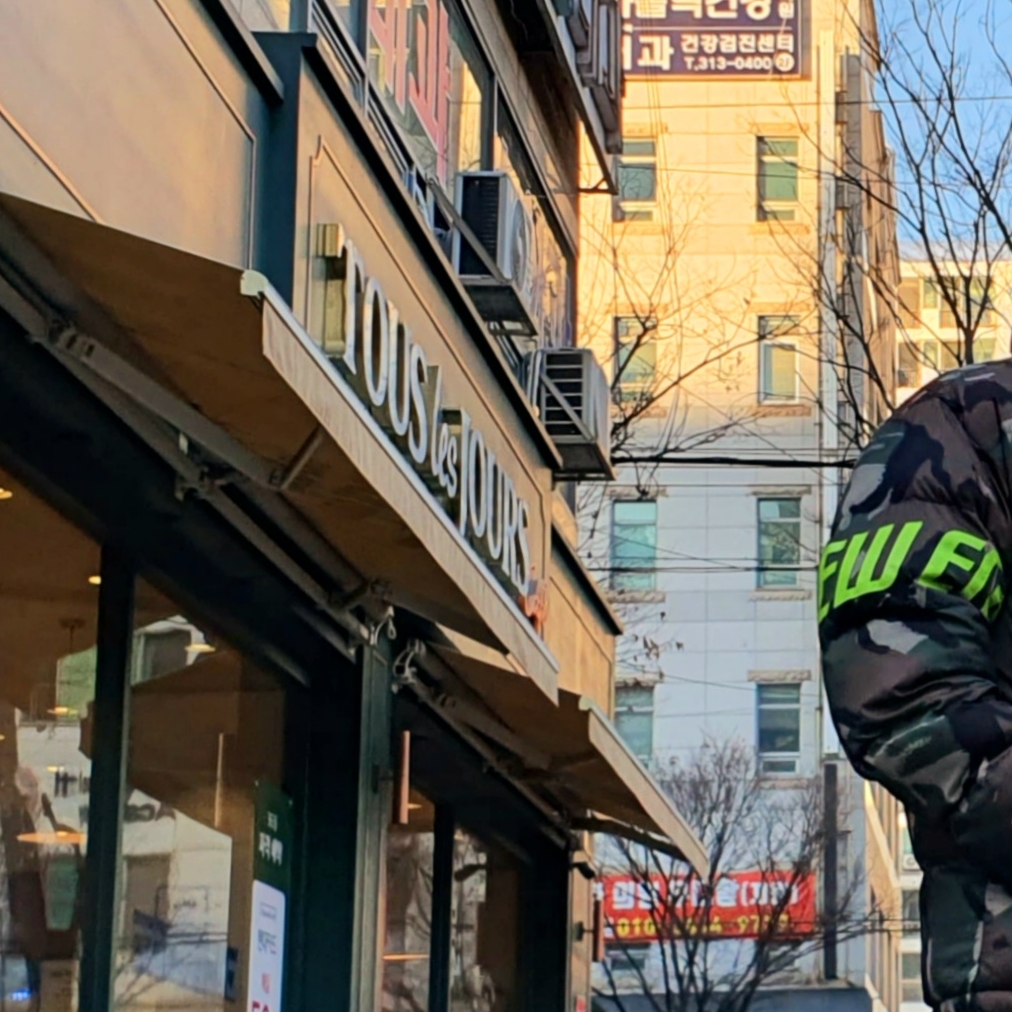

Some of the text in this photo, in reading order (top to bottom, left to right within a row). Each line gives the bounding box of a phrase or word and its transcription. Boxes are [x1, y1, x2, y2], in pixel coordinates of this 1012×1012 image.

[680, 33, 794, 54] 건강검진센터
[336, 223, 429, 464] TOUS
[431, 365, 458, 498] les
[457, 405, 530, 597] JOURS
